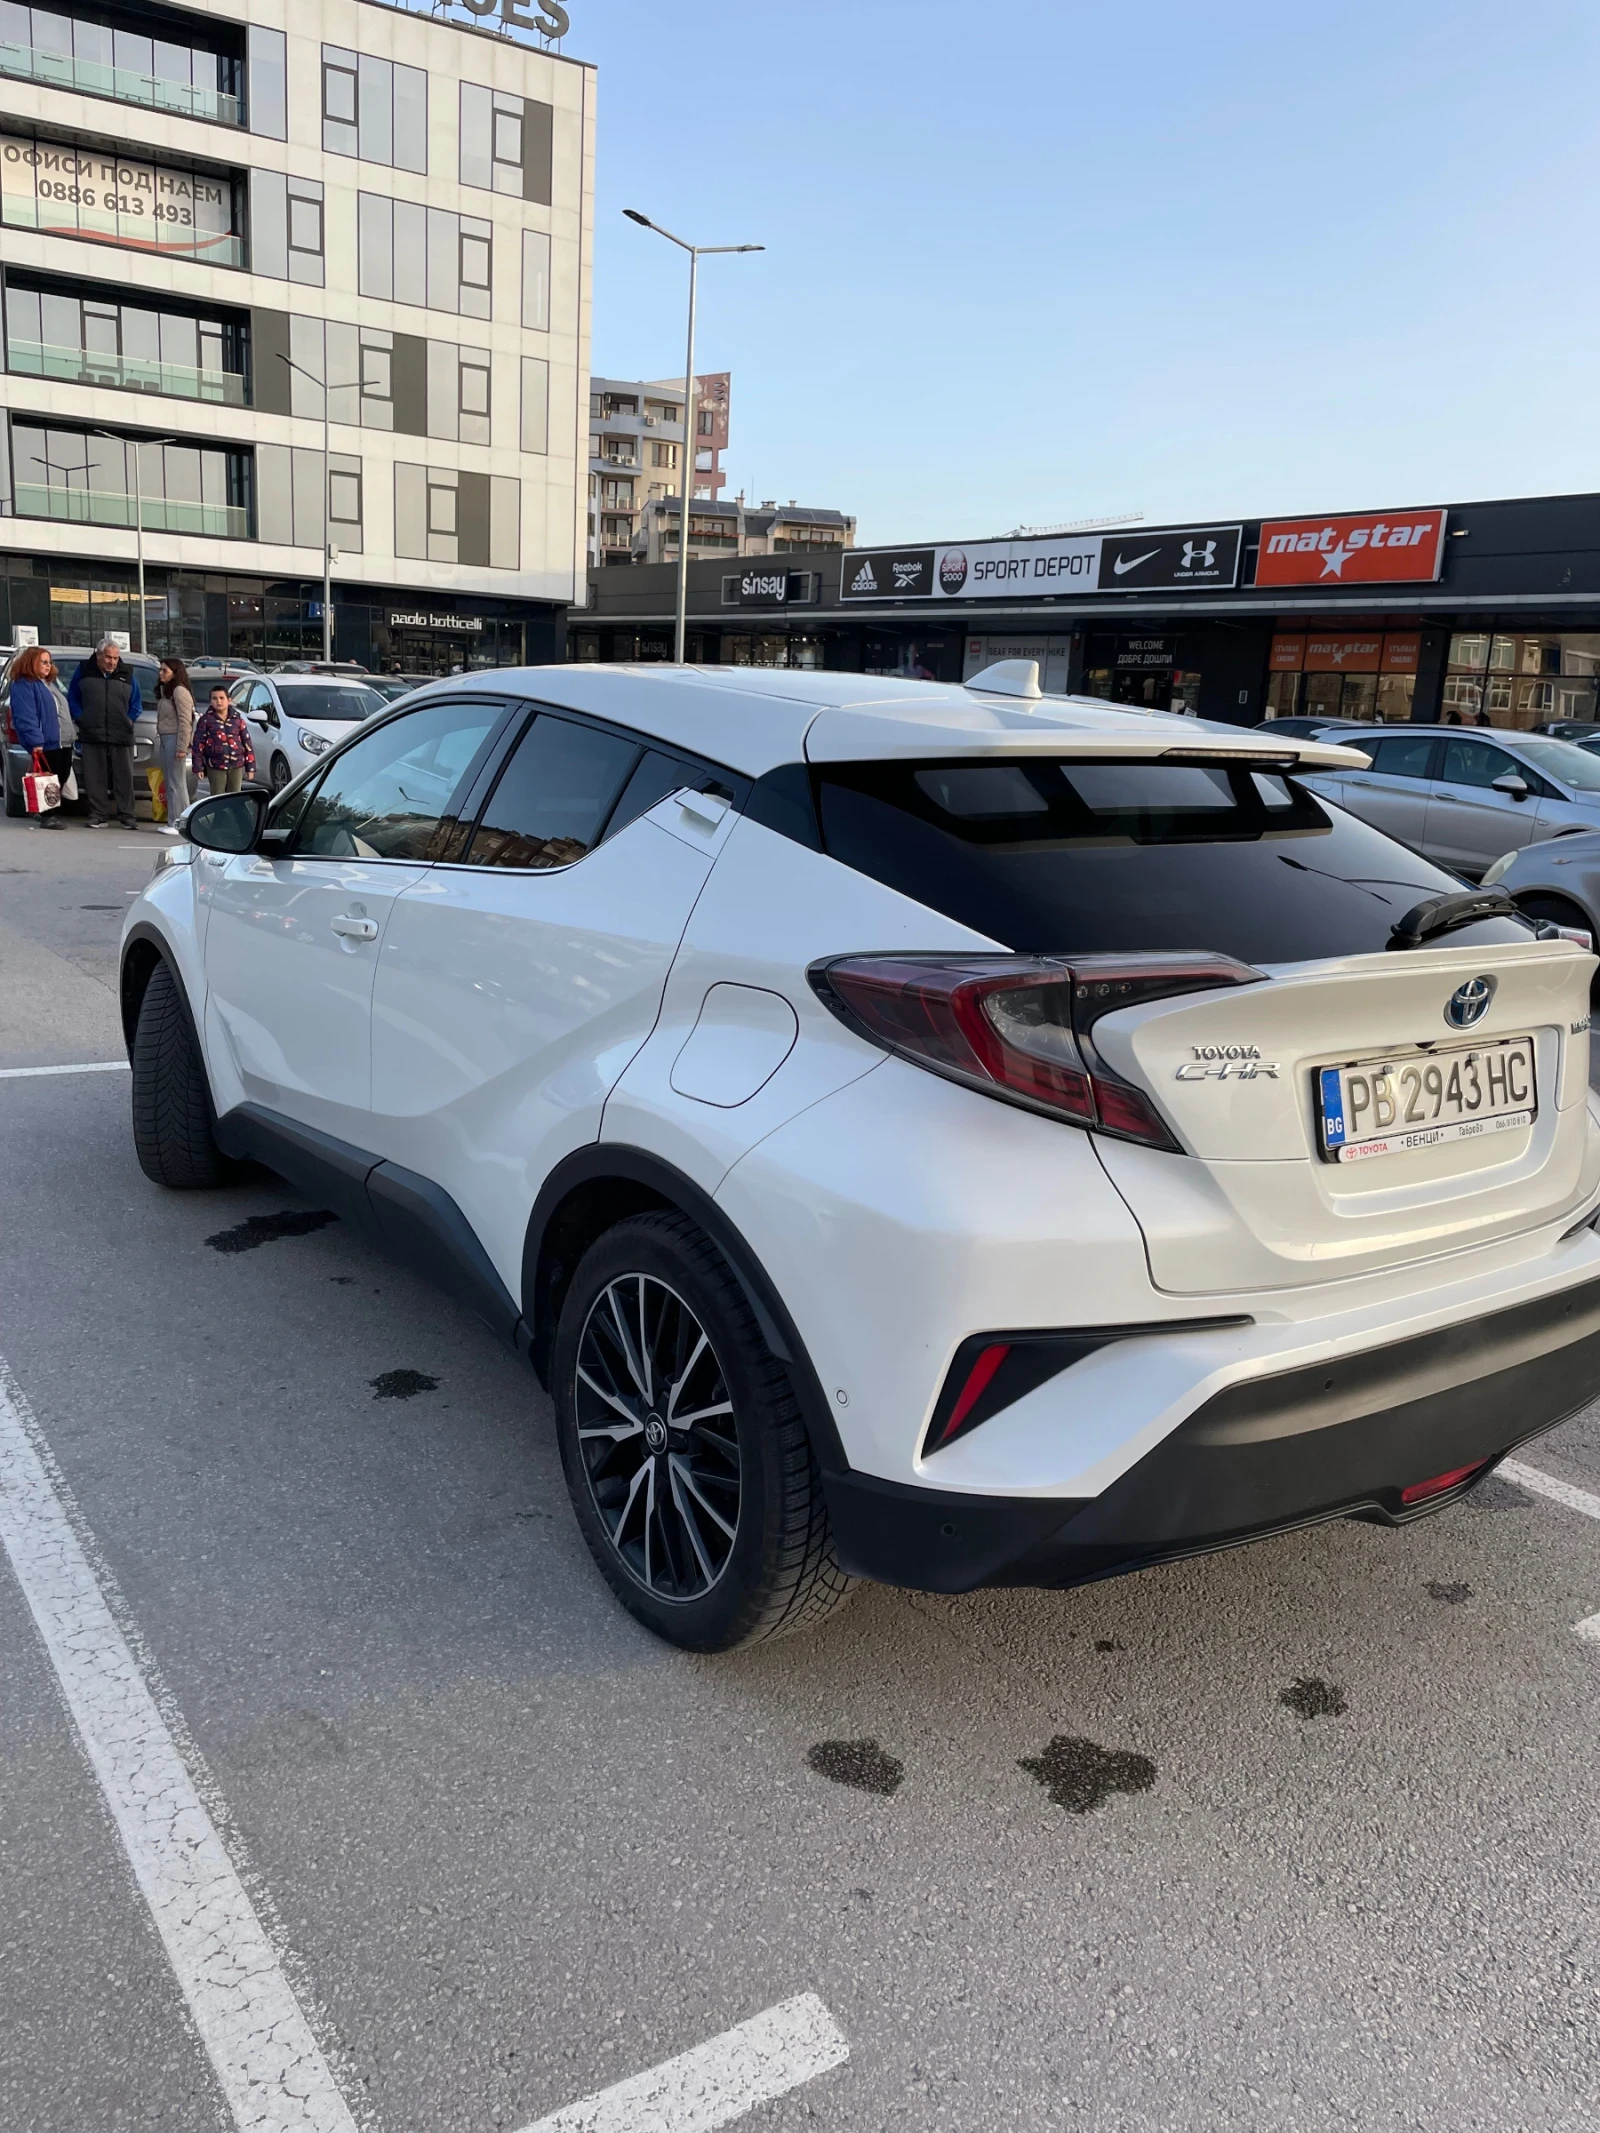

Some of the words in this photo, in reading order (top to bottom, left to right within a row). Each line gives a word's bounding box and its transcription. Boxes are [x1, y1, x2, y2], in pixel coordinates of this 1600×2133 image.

[3, 145, 93, 179] ОФИСИ
[100, 164, 153, 194] ПОД
[159, 176, 223, 206] НАЕМ
[38, 179, 96, 207] 0886
[103, 192, 145, 216] 613
[152, 202, 192, 226] 493
[1266, 527, 1338, 554] mat
[1345, 524, 1433, 550] star
[892, 561, 923, 573] Reebok
[941, 562, 966, 572] SPORT
[974, 559, 1030, 580] SPORT
[1034, 554, 1095, 578] DEPOT
[741, 571, 786, 601] sinsay
[851, 580, 878, 591] adidas
[942, 572, 963, 582] 2000
[391, 612, 427, 626] paolo
[429, 613, 483, 630] botticelli
[1008, 647, 1021, 656] FOR
[1023, 647, 1046, 657] EVERY
[1048, 648, 1066, 656] HIKE
[1128, 640, 1165, 650] WELCOME
[1117, 654, 1142, 665] ДОБРЕ
[1143, 654, 1173, 665] ДОШЛИ
[1193, 1045, 1261, 1060] TOYOTA
[1175, 1062, 1281, 1081] C-HR
[1345, 1071, 1397, 1132] PB
[1400, 1060, 1483, 1123] 2943
[1487, 1051, 1529, 1107] HC
[1327, 1118, 1344, 1136] BG
[1358, 1143, 1388, 1155] TOYOTA
[1406, 1131, 1439, 1148] ВЕНЦИ
